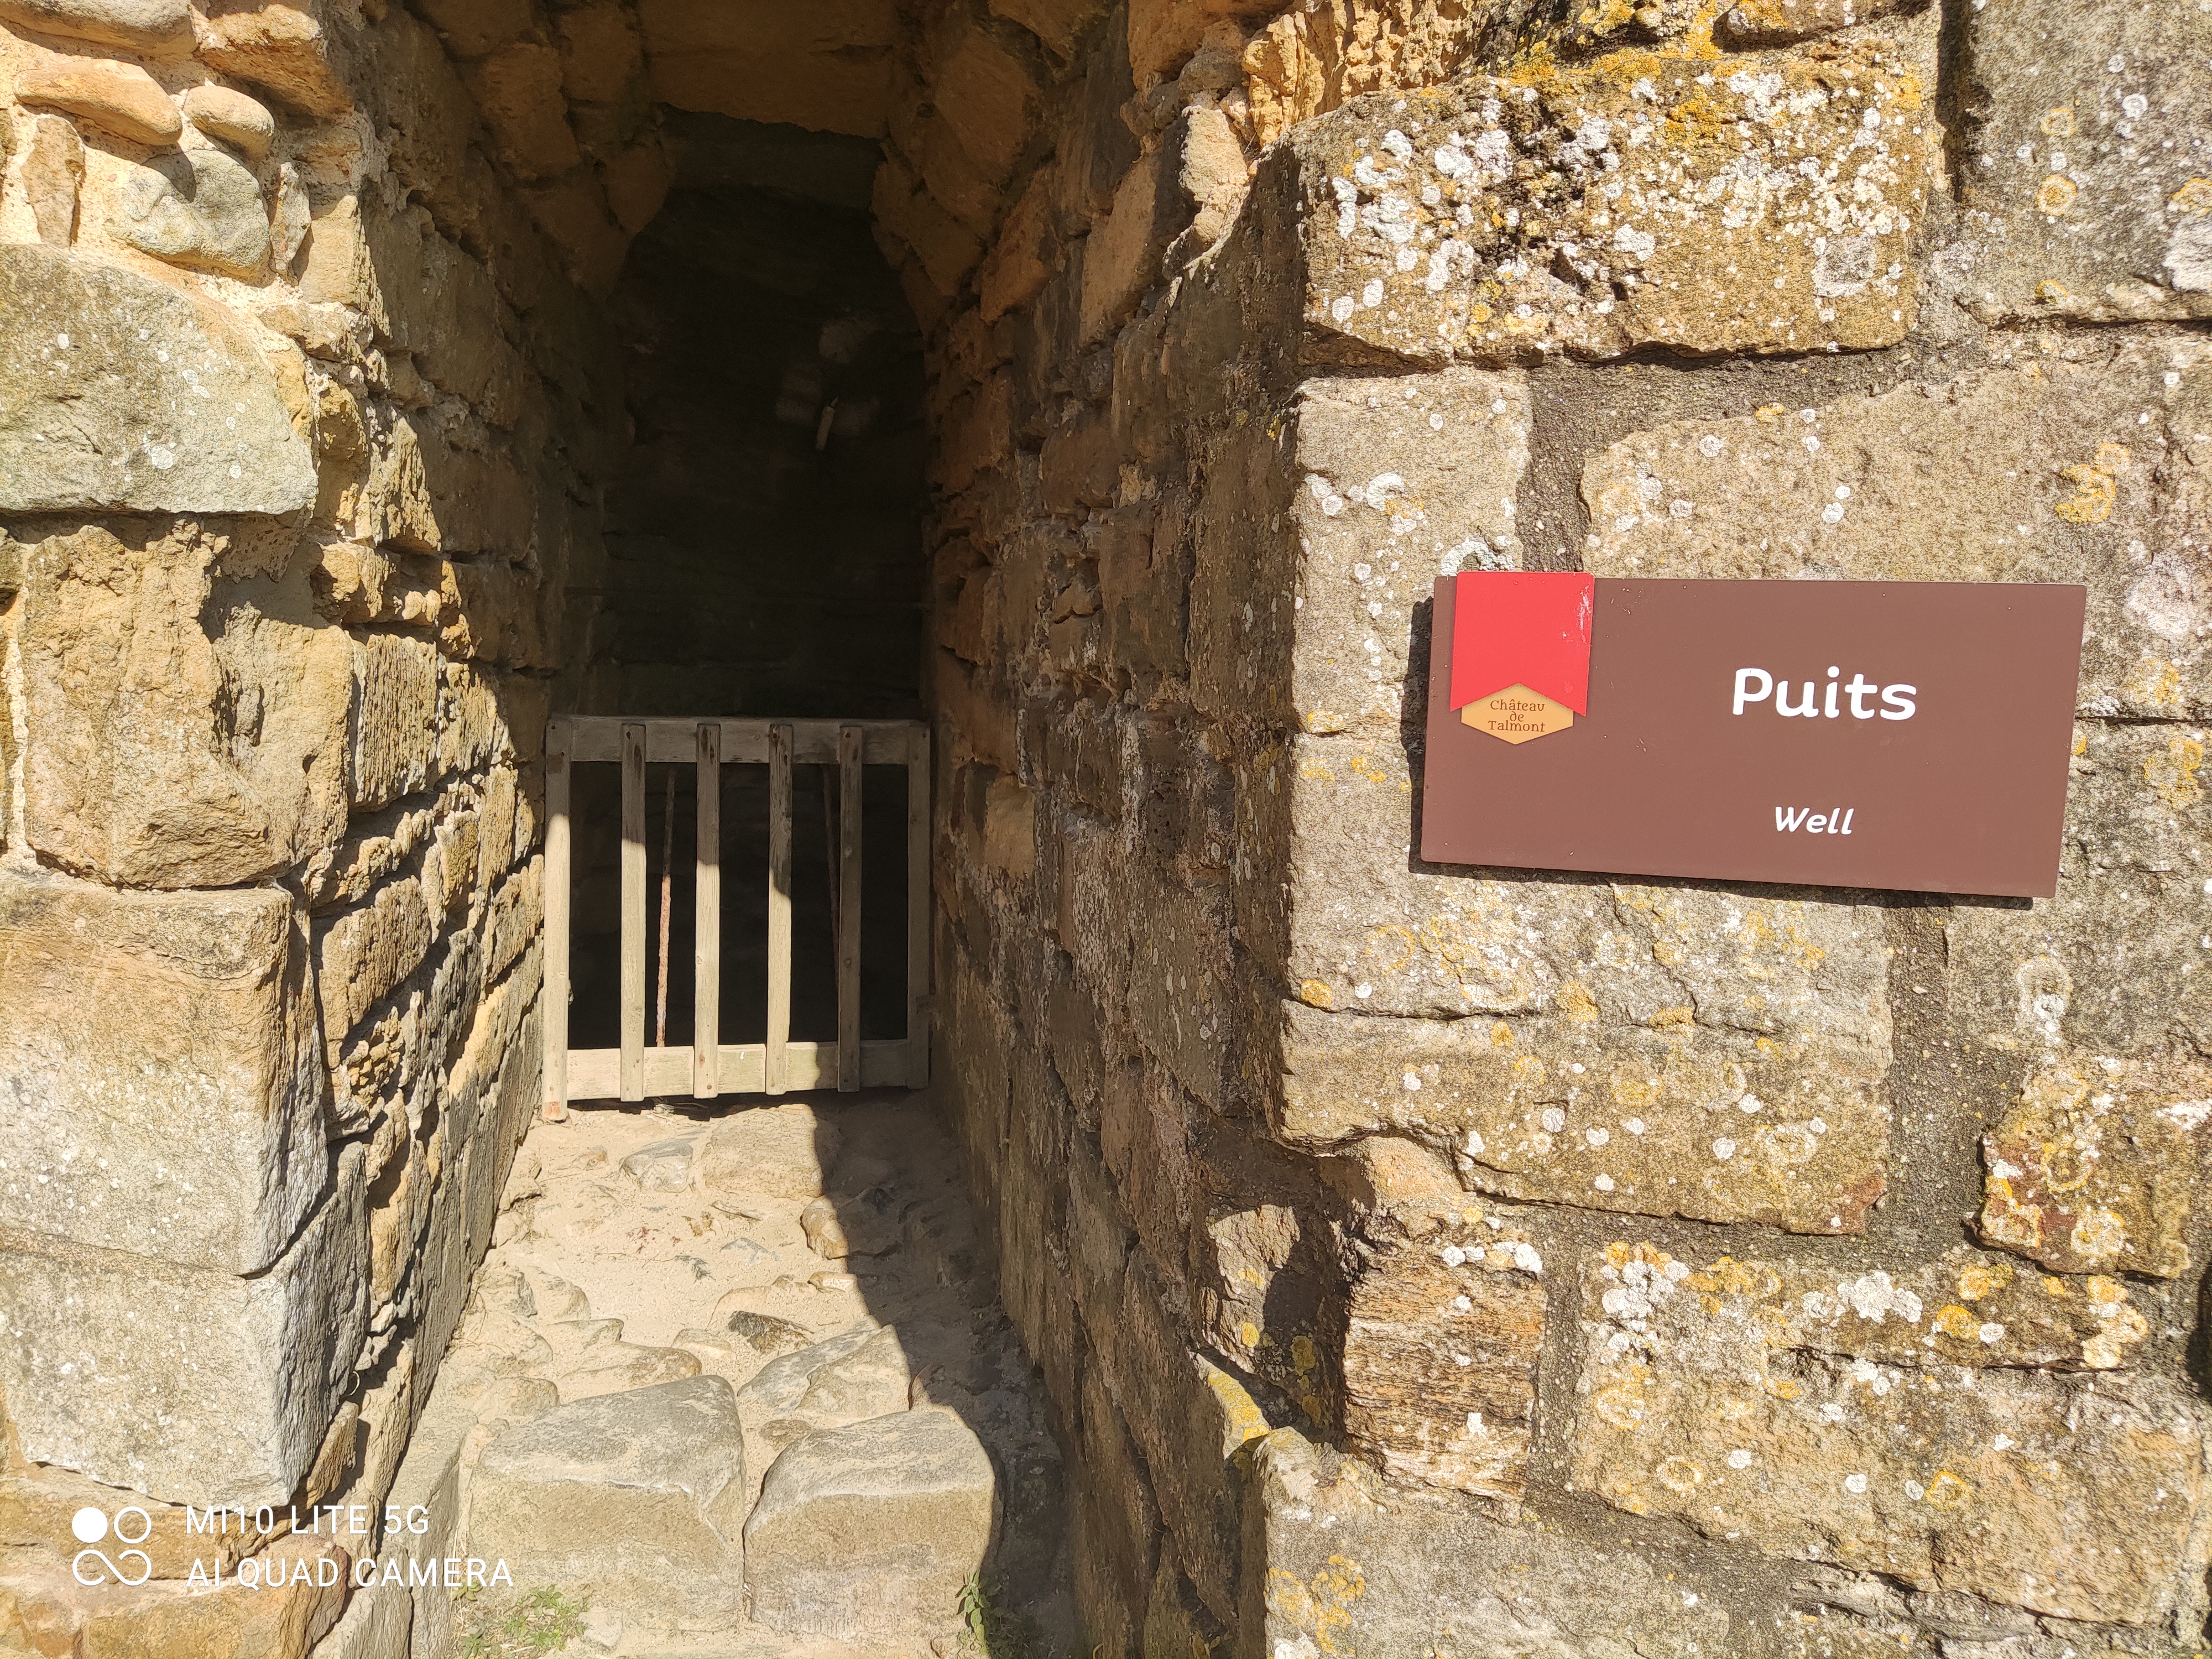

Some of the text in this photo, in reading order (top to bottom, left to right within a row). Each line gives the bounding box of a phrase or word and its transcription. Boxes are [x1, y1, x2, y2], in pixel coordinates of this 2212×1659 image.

[1732, 666, 1917, 720] Puits
[1490, 698, 1545, 711] Château
[1510, 711, 1524, 722] de
[1488, 720, 1546, 732] Talmont
[1775, 806, 1854, 834] Well
